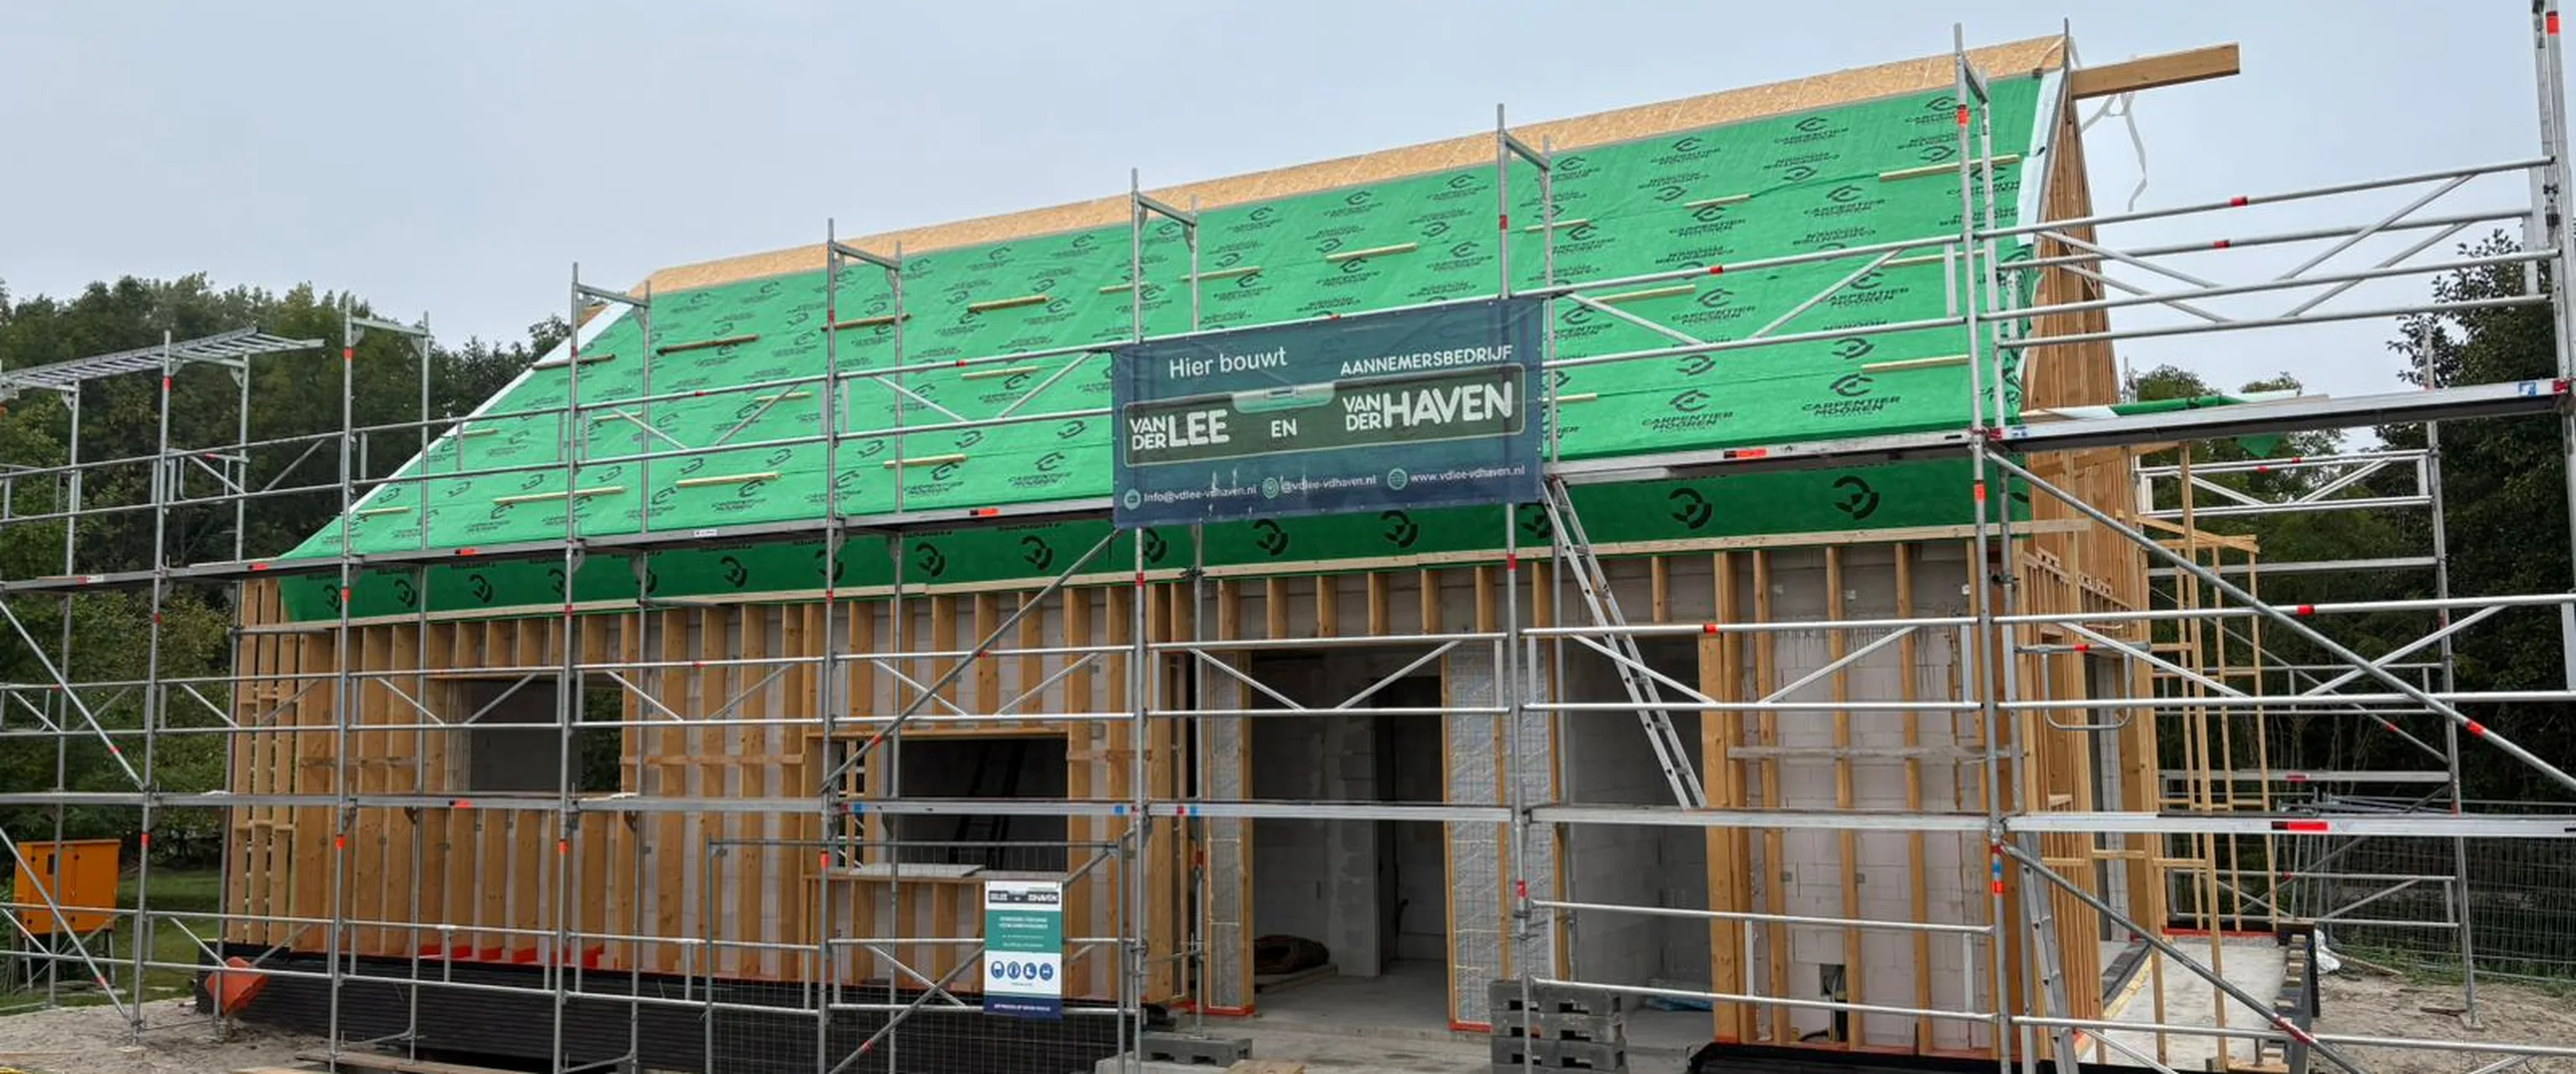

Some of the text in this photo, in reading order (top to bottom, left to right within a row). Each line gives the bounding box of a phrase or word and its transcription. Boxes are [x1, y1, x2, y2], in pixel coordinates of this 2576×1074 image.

[1828, 287, 1909, 301] ARPENTIER
[1169, 346, 1288, 379] Hier bouwt
[1340, 345, 1514, 377] AANNEMERSBEDRIJF
[1343, 394, 1381, 413] VAN
[1383, 381, 1514, 428] HAVEN
[1802, 396, 1901, 411] CARPENTIER
[1129, 415, 1167, 434] VAN
[1345, 413, 1382, 432] DER
[1641, 411, 1733, 425] CARPENTIER
[1168, 409, 1298, 447] LEE EN
[1132, 434, 1167, 451] DER
